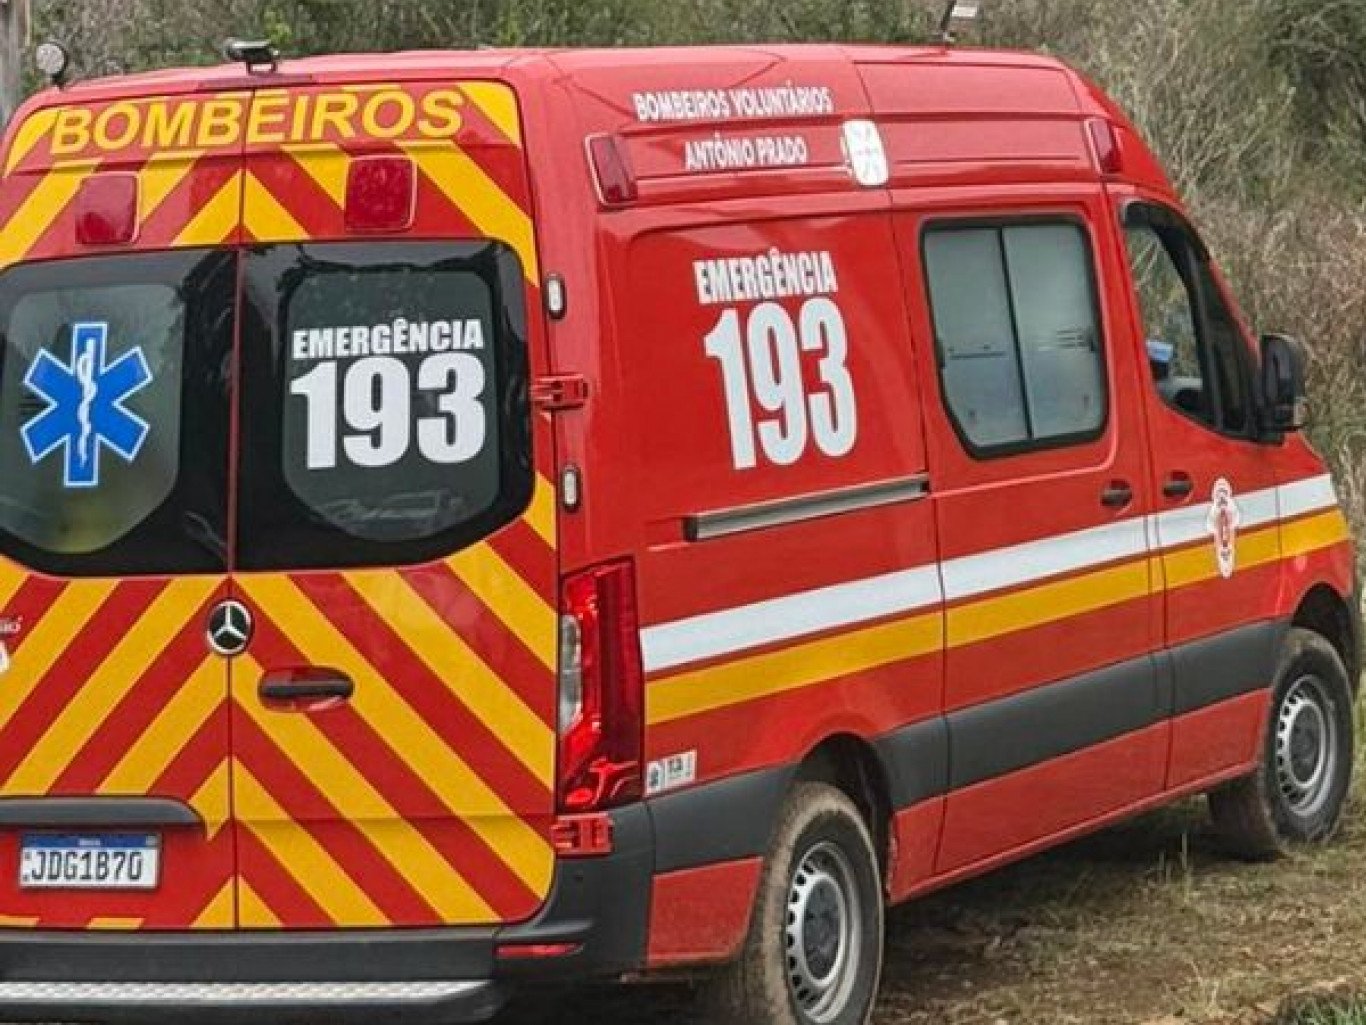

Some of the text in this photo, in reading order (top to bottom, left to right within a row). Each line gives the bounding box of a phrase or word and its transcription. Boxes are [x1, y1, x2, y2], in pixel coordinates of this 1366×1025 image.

[50, 89, 464, 154] BOMBEIROS
[632, 79, 834, 121] BOMBEIROS VOLUNTÁRIOS
[685, 131, 808, 170] ANTÔNIO PRADO
[693, 246, 838, 304] EMERGÊNCIA
[292, 317, 484, 360] EMERGÊNCIA
[703, 297, 857, 470] 193
[289, 353, 486, 469] 193
[31, 850, 143, 881] JDG1B70
